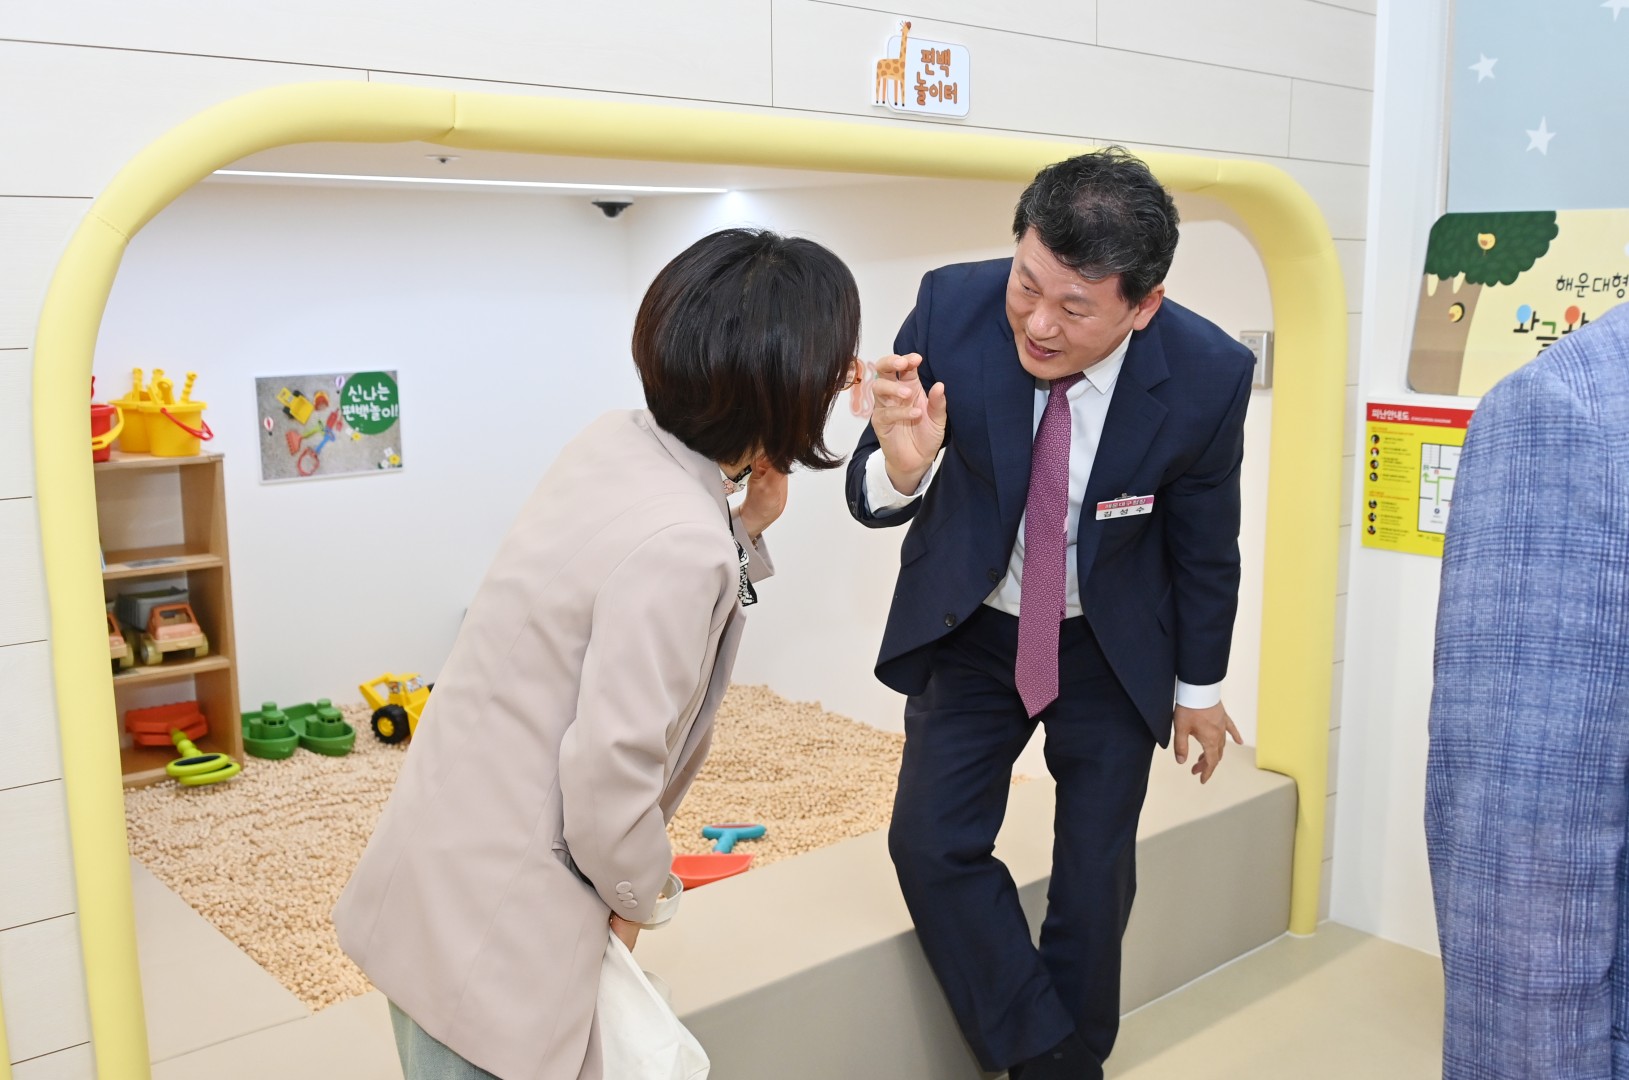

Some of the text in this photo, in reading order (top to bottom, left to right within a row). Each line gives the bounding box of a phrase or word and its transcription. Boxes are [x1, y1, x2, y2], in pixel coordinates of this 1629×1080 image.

[920, 47, 951, 78] 편백
[913, 71, 958, 106] 놀이터
[1556, 272, 1629, 299] 해운대형
[347, 382, 391, 403] 신나는
[342, 402, 399, 422] 편백놀이!
